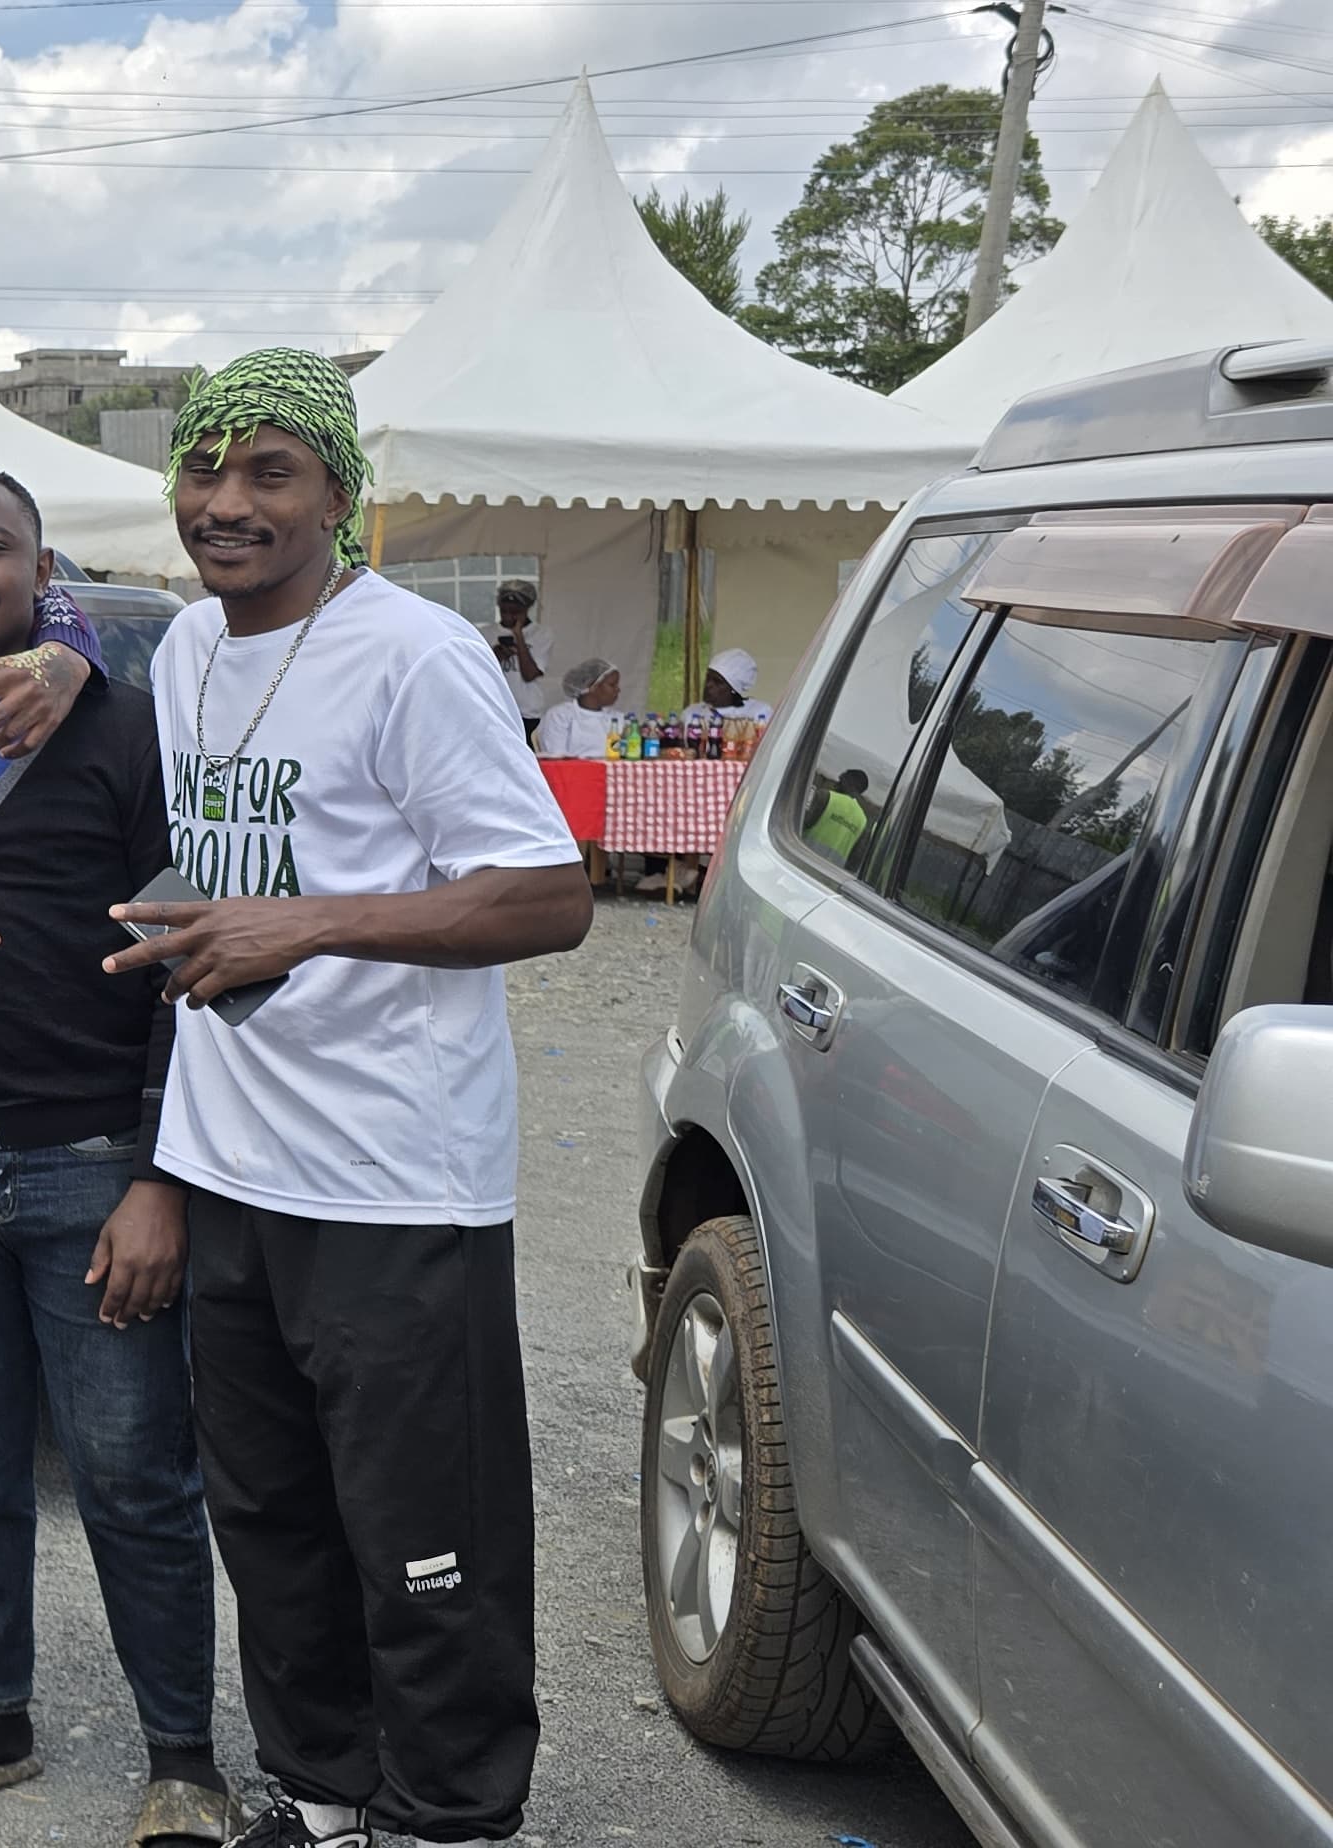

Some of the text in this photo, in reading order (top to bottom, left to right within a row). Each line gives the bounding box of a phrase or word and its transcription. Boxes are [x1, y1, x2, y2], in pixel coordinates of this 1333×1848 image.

[171, 750, 302, 826] UN FOR
[205, 807, 225, 819] RUN
[169, 820, 302, 899] OOLUA
[405, 1571, 462, 1594] Vintage
